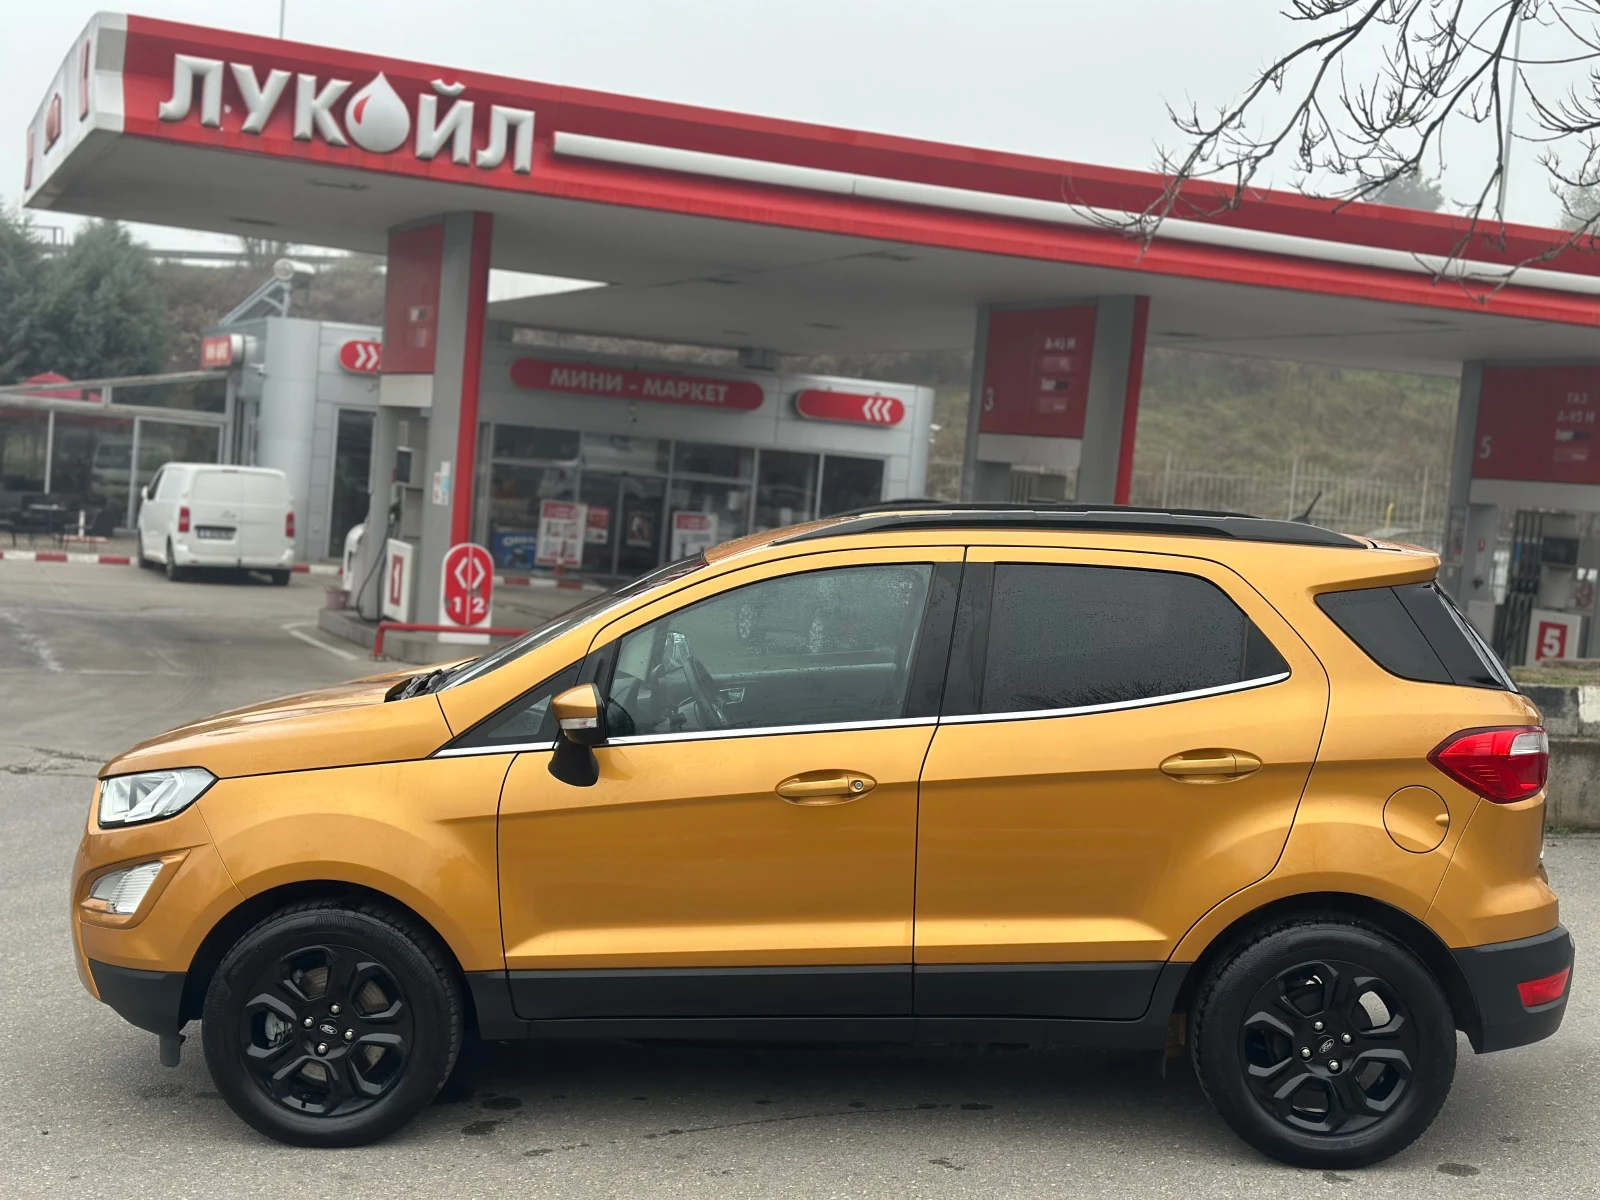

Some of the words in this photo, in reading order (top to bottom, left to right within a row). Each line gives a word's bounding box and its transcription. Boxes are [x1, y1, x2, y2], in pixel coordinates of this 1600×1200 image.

[550, 368, 623, 391] МИНИ
[643, 378, 728, 402] МАРКЕТ
[984, 388, 995, 411] 3
[1480, 437, 1491, 459] 5
[453, 597, 461, 613] 1
[472, 598, 485, 613] 2
[1542, 628, 1560, 657] 5
